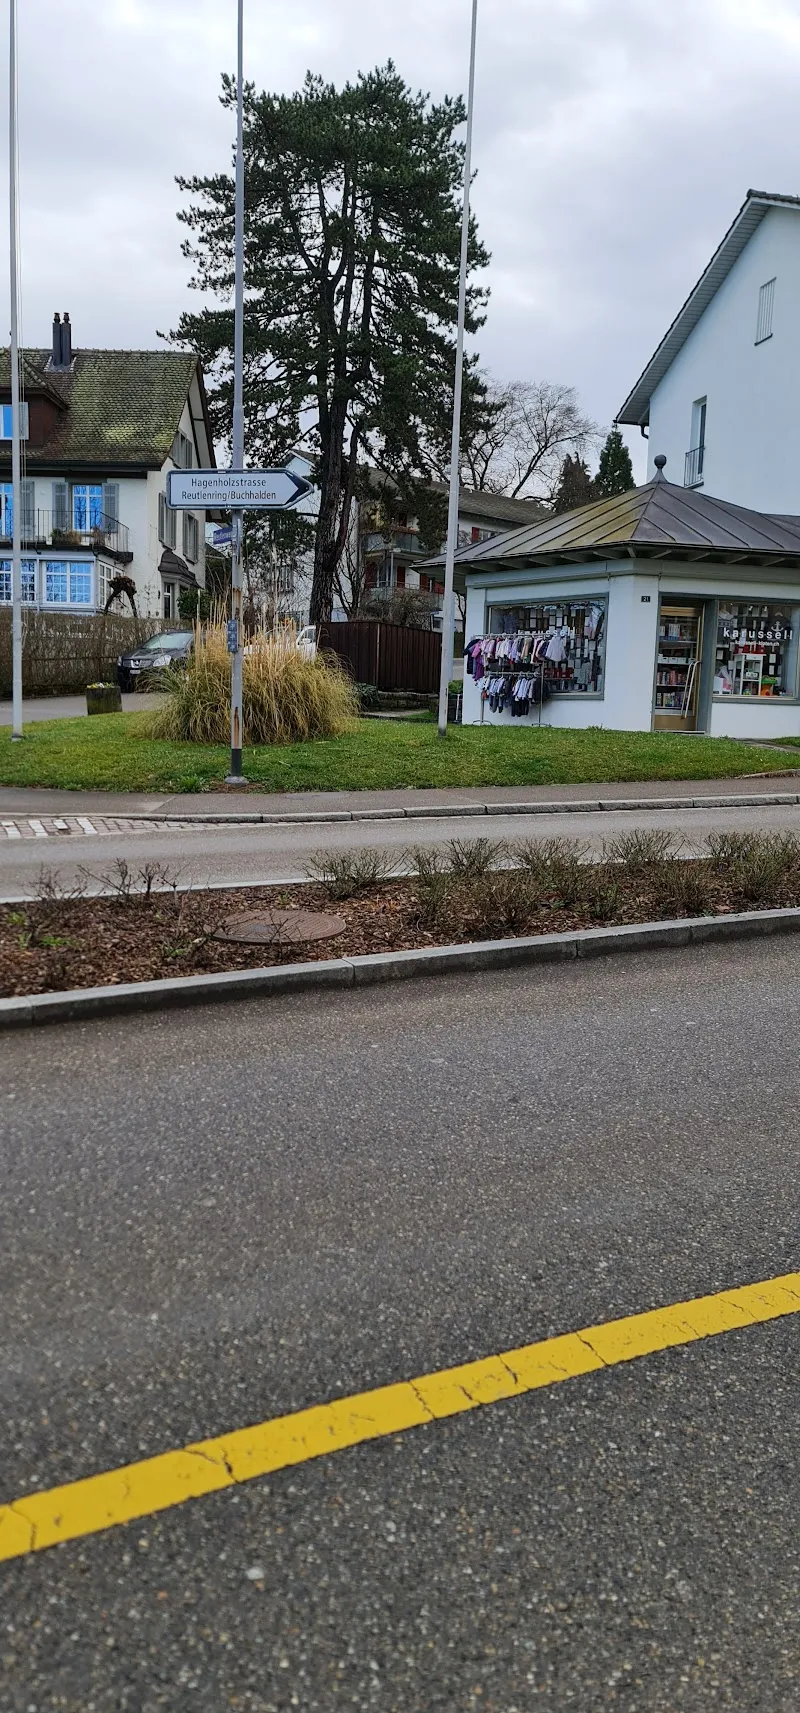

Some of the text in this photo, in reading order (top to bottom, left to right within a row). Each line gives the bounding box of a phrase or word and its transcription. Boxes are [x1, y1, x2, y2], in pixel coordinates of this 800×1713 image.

[191, 478, 267, 489] Hagenholzstrasse
[181, 490, 277, 501] Reutlenring/Buchhalden
[723, 627, 793, 640] karussell
